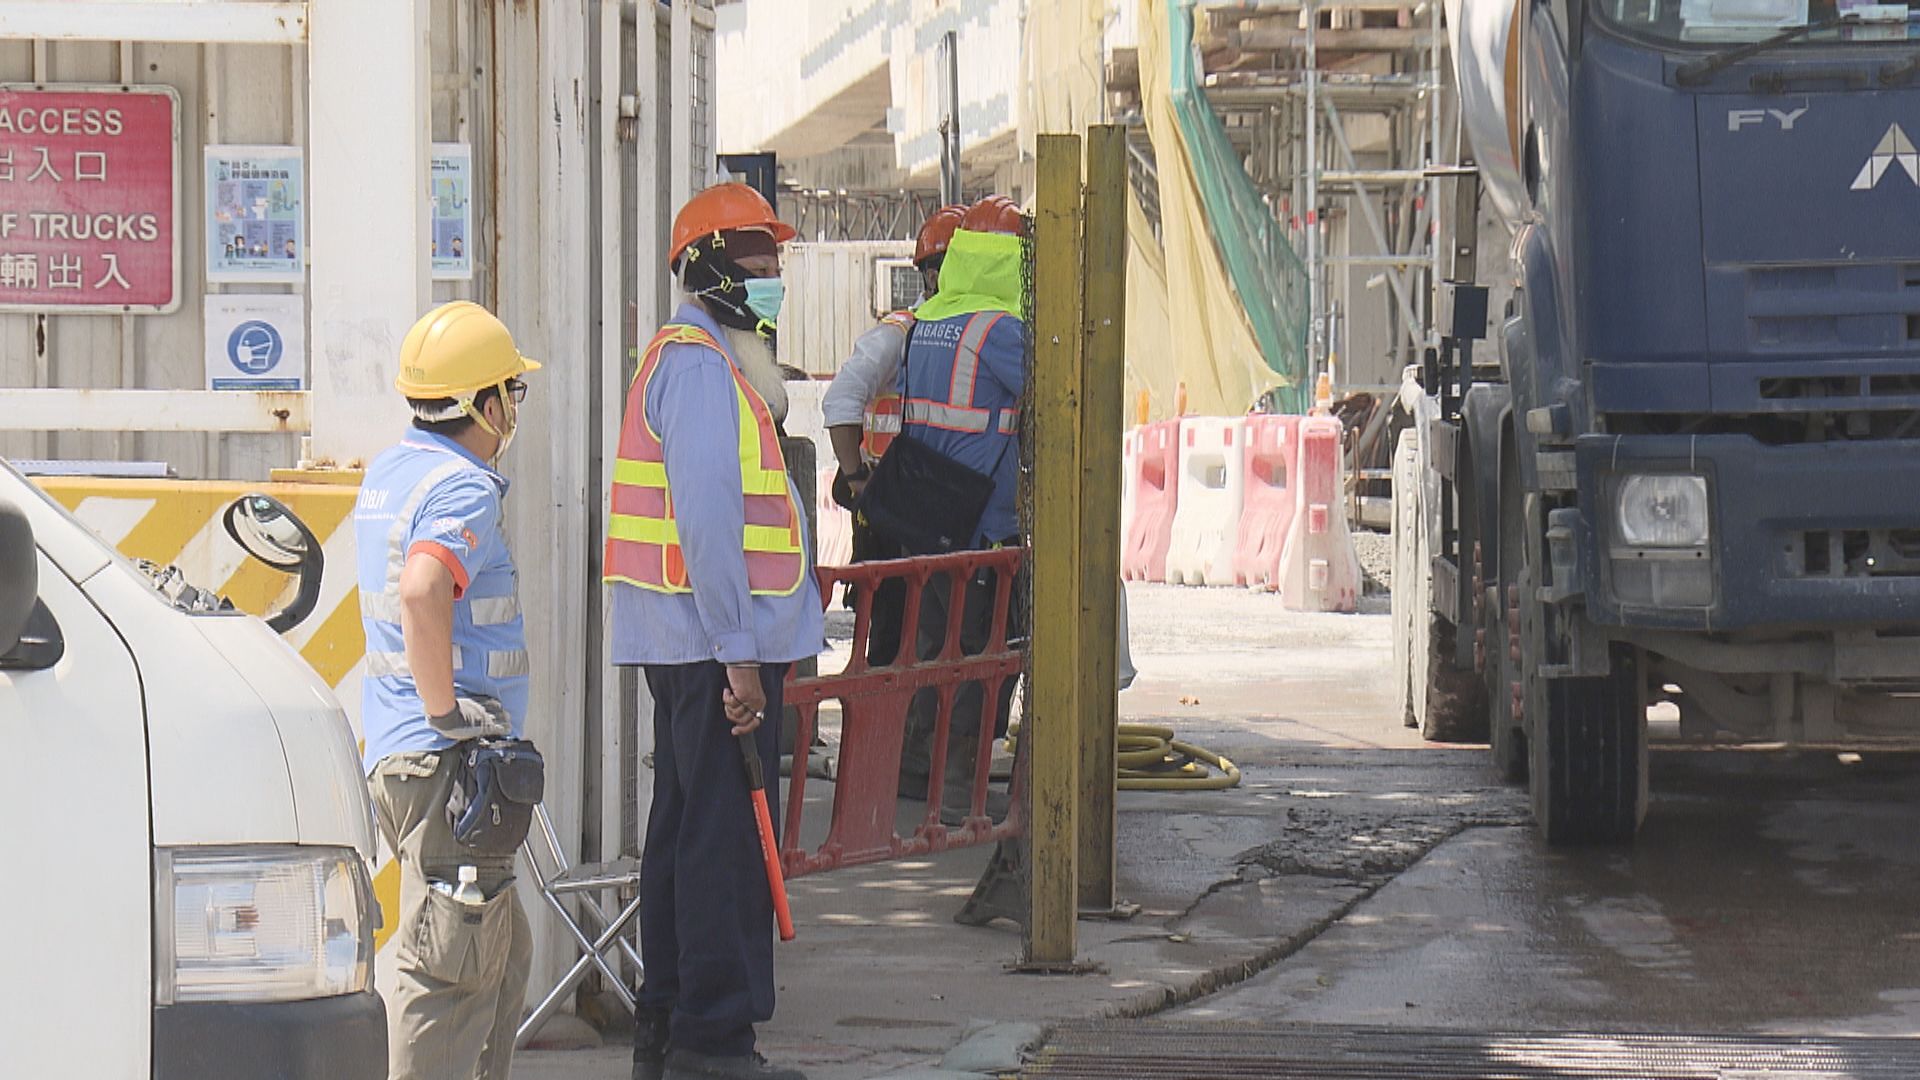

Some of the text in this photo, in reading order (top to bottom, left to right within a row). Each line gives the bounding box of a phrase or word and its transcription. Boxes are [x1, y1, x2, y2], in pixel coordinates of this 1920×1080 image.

[0, 108, 123, 135] ACCESS
[30, 213, 159, 241] TRUCKS
[1, 253, 131, 289] 輛出入
